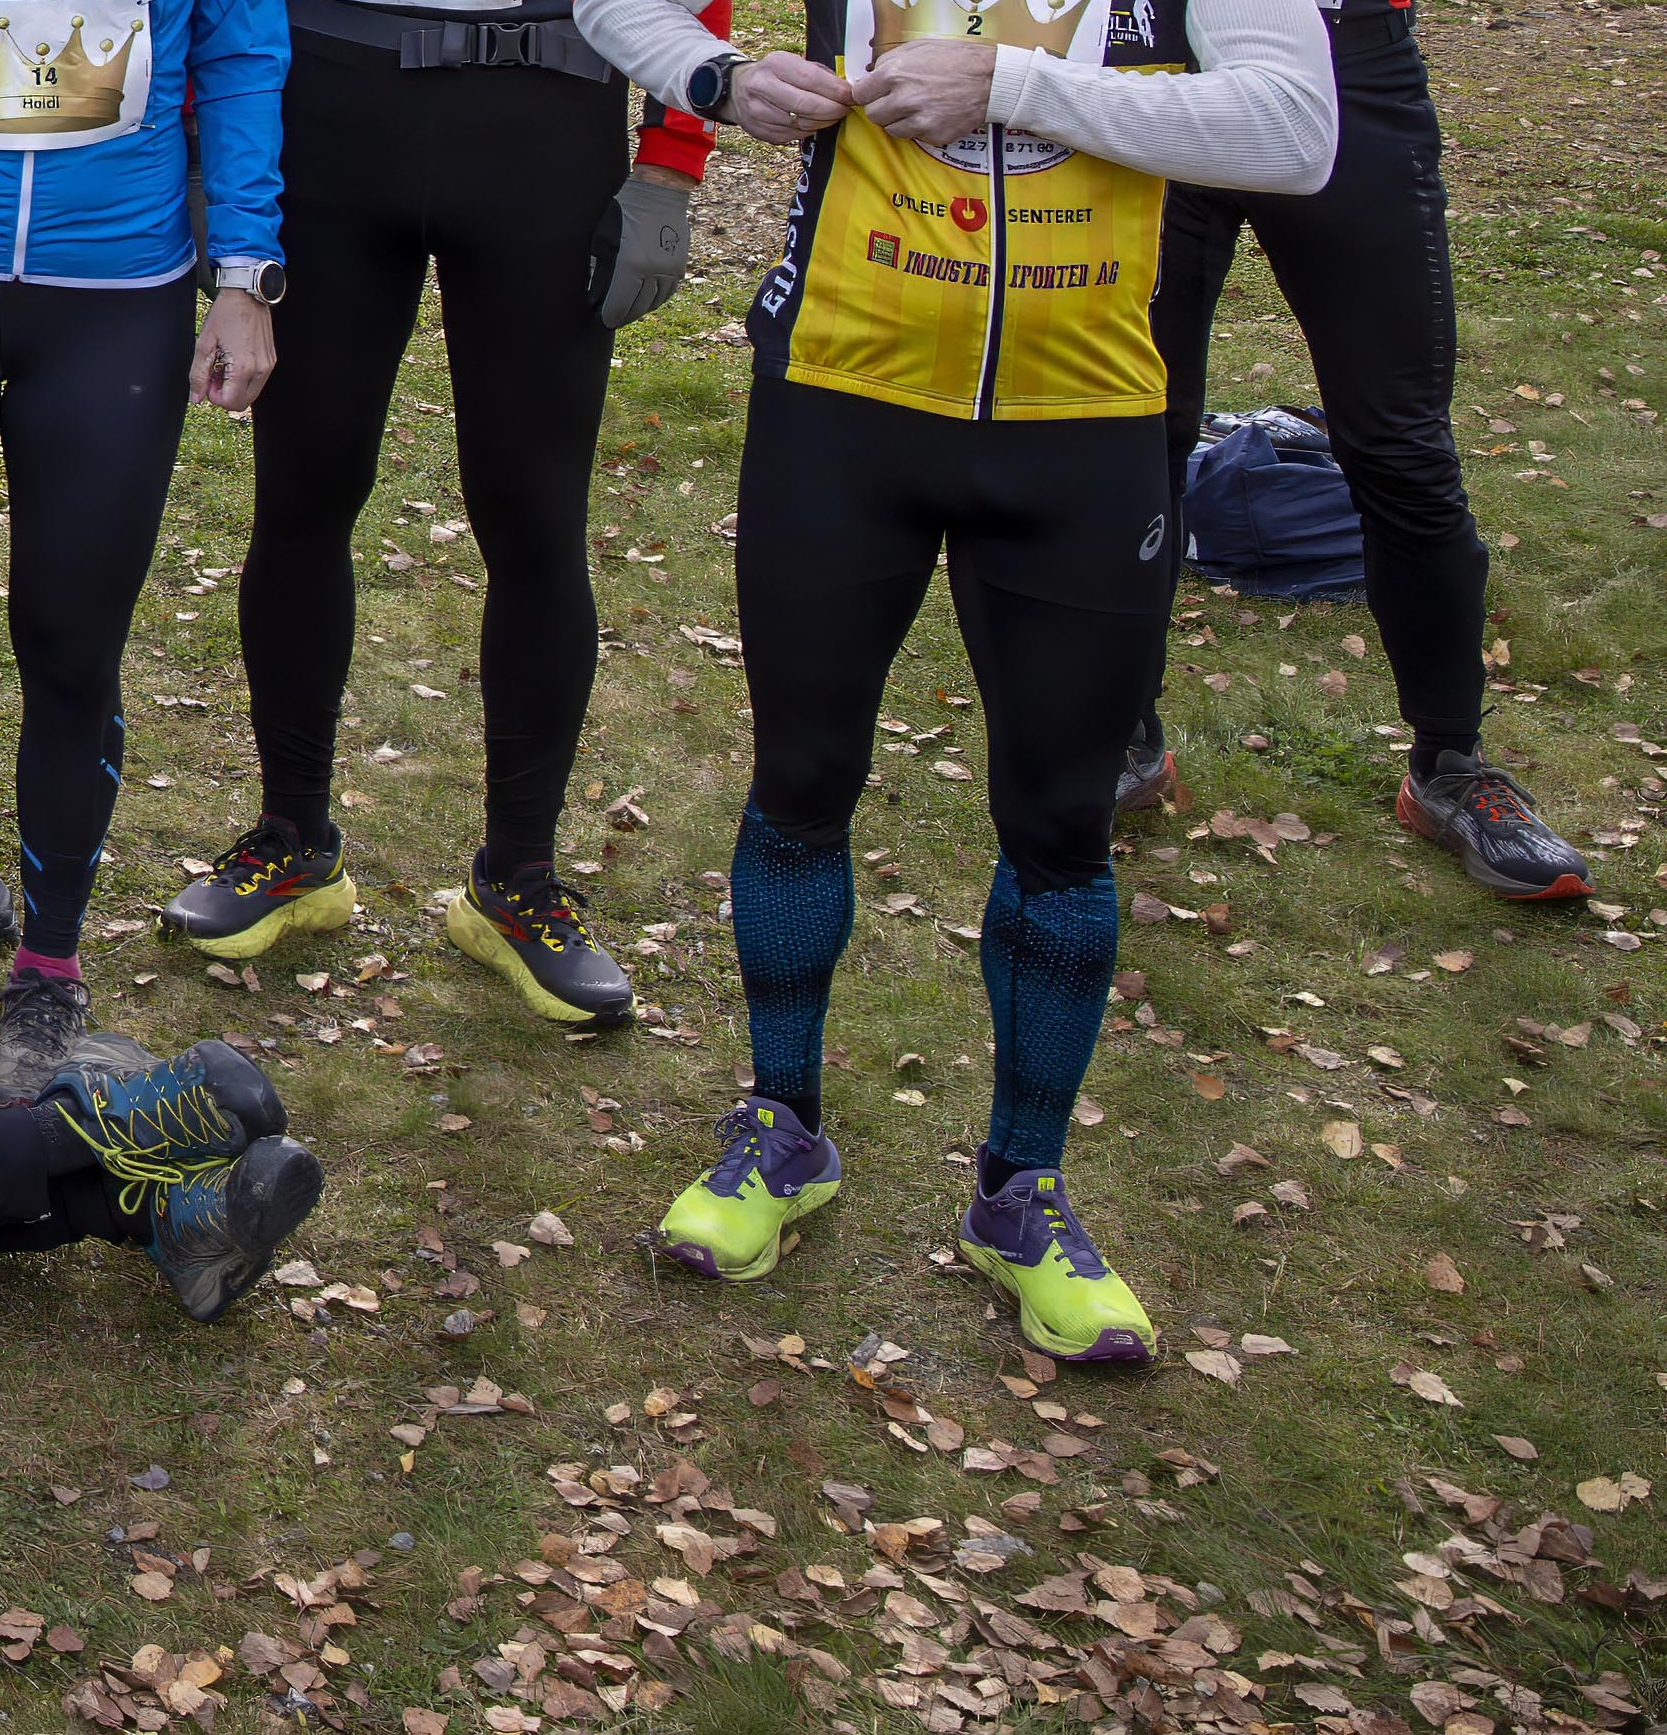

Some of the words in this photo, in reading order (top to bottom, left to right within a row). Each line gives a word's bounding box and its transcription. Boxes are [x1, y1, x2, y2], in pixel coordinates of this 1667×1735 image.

[967, 15, 983, 35] 2
[31, 67, 58, 85] 14
[892, 192, 948, 217] UTLEIE
[1008, 208, 1093, 224] SENTERET
